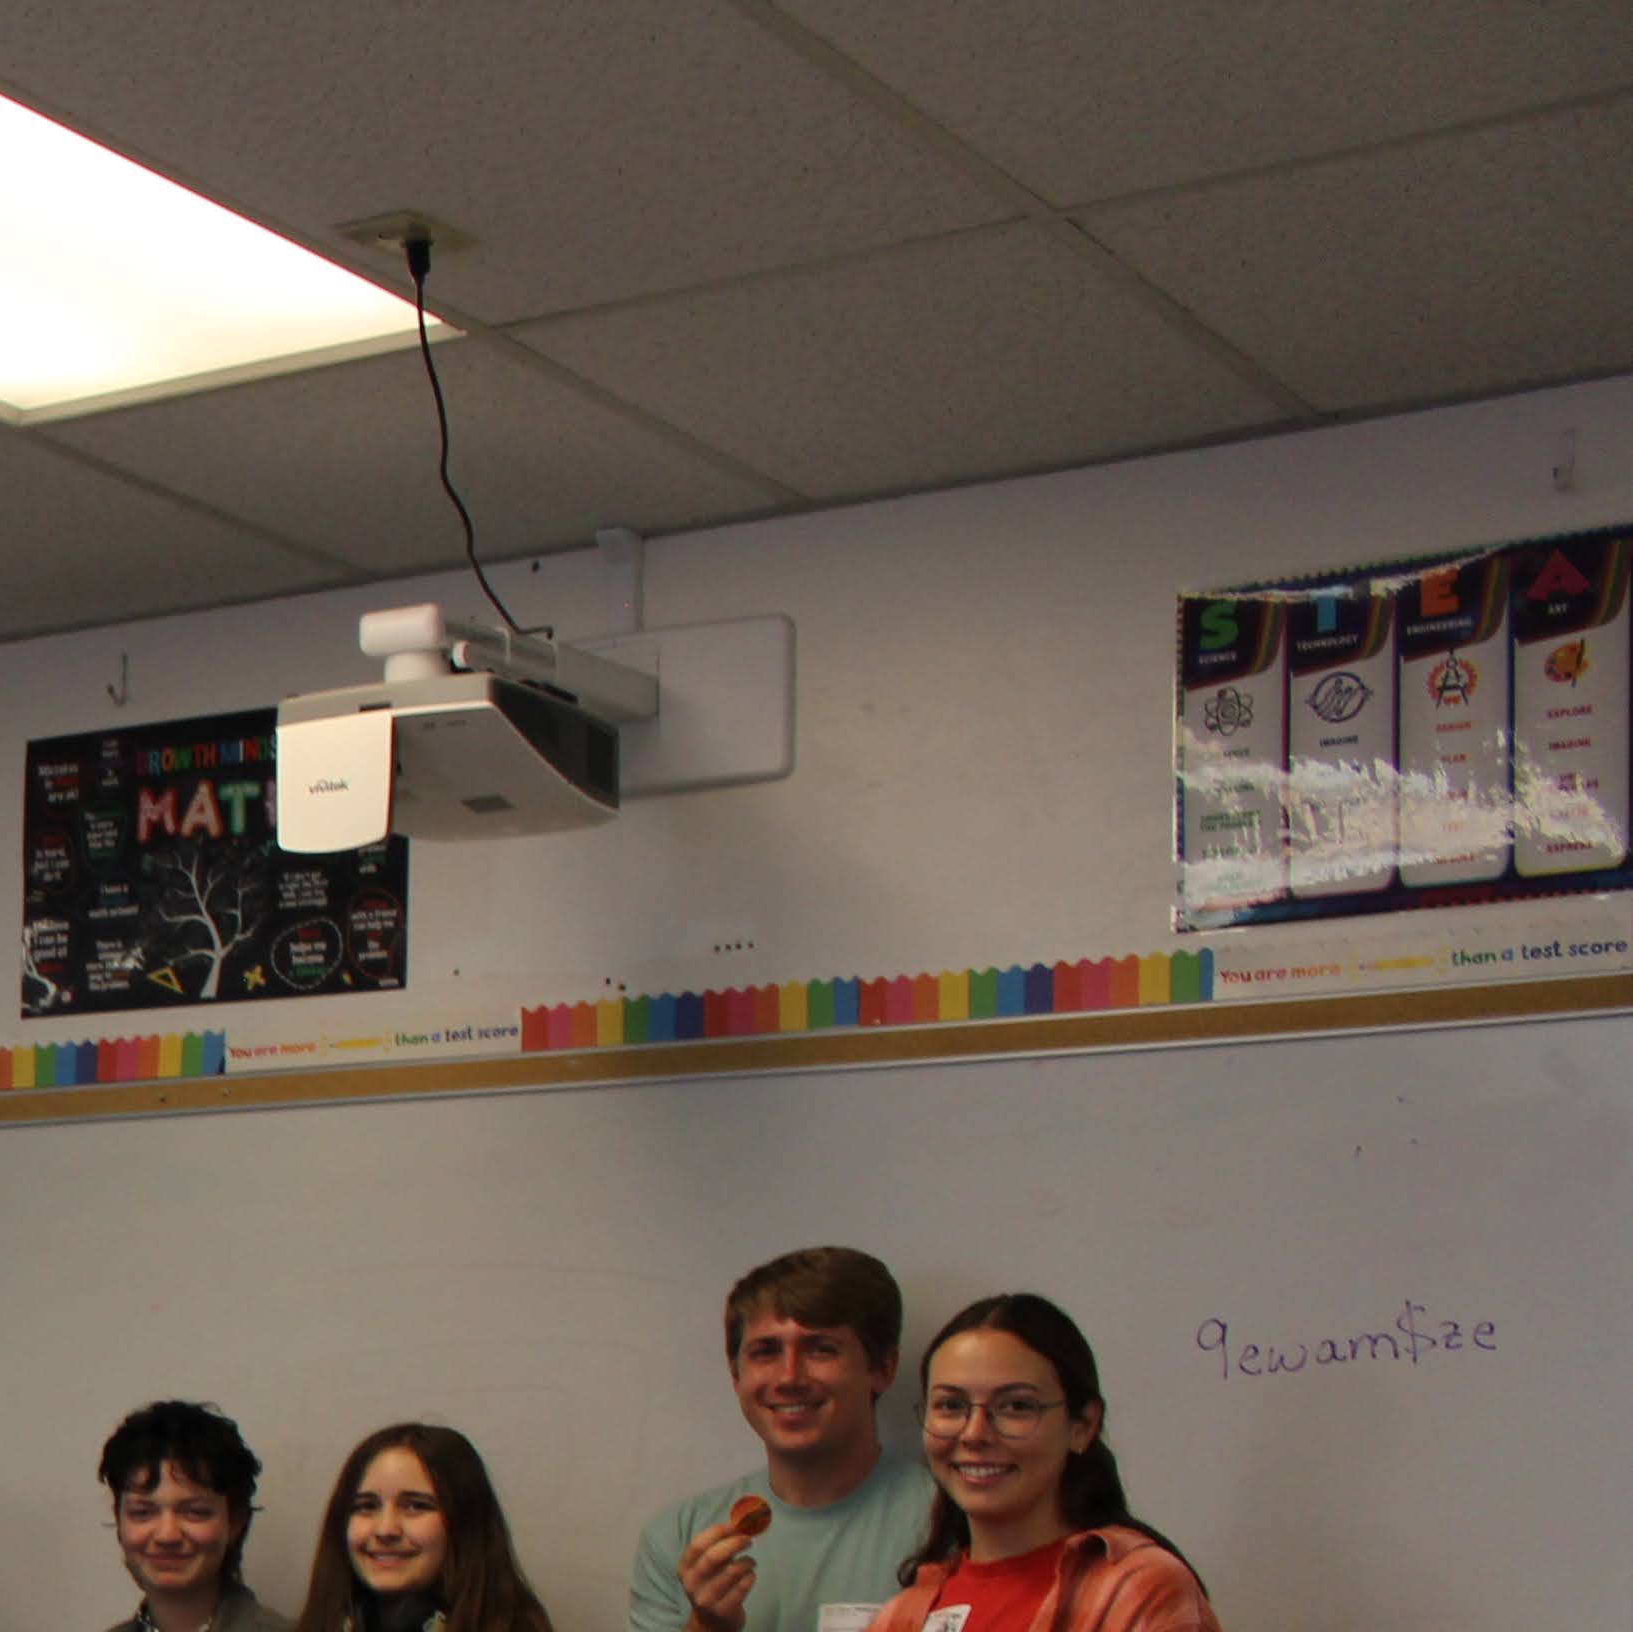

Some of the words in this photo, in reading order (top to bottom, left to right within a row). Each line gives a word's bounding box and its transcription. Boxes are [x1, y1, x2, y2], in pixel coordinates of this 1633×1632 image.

[1451, 951, 1497, 968] than
[1521, 941, 1564, 960] test
[1568, 938, 1629, 958] score
[395, 1031, 429, 1047] than
[445, 1025, 474, 1043] test
[477, 1024, 519, 1039] score
